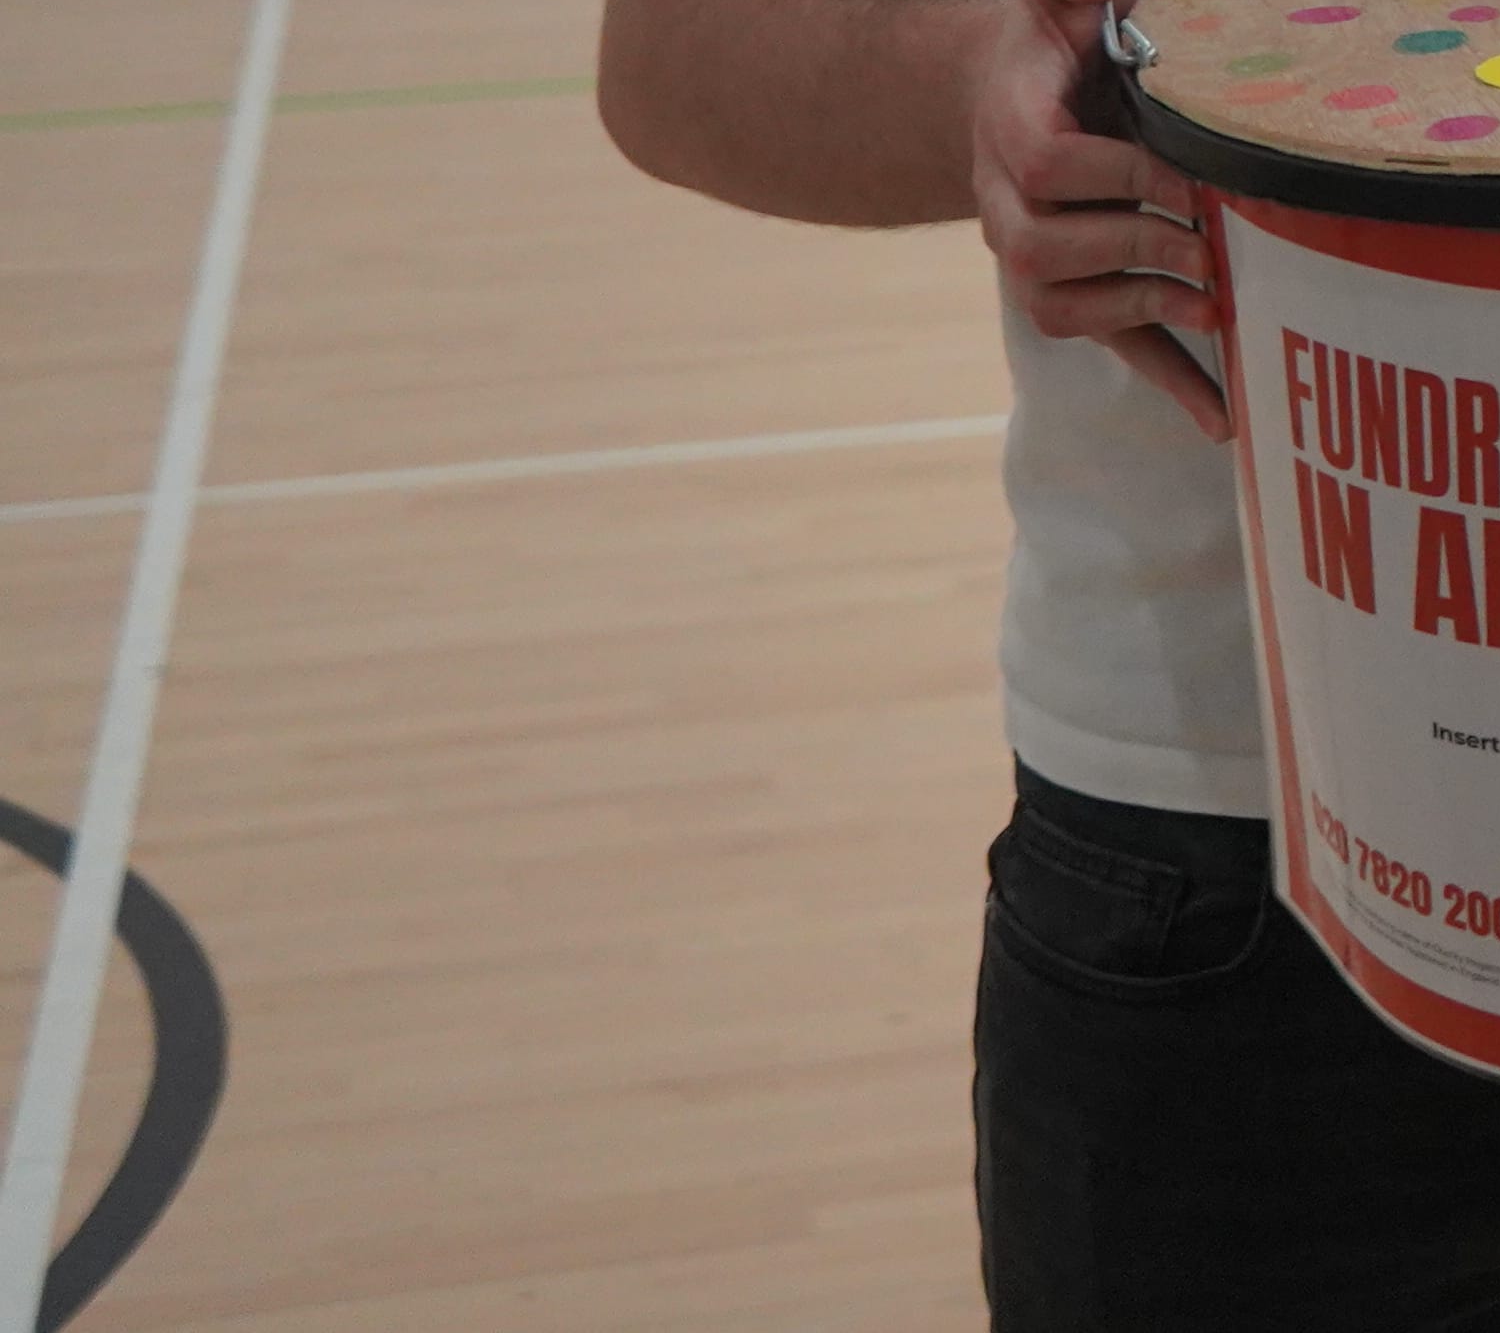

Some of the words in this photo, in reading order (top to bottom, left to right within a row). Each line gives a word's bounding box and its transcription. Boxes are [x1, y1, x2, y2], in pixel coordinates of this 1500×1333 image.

[1293, 456, 1377, 616] IN
[1431, 721, 1500, 754] Insert
[1354, 836, 1433, 917] 7820
